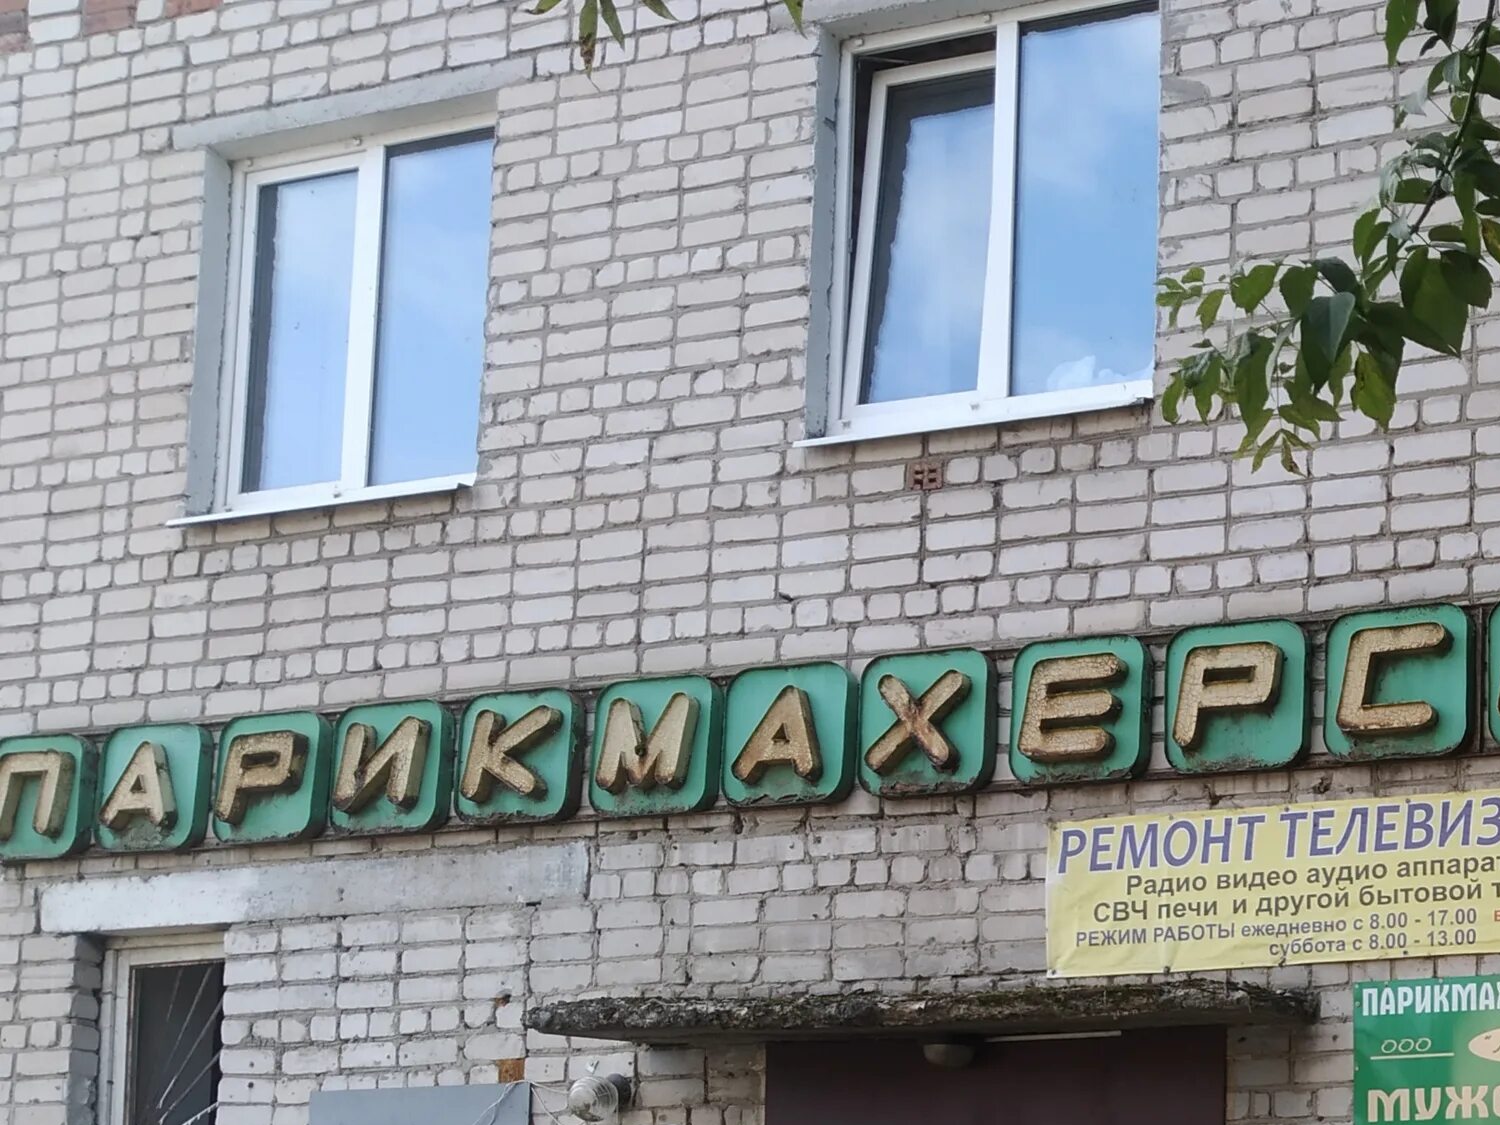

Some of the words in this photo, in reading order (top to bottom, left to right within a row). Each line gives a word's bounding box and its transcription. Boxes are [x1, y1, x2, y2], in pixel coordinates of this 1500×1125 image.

[1057, 813, 1268, 874] РЕМОНТ
[1126, 875, 1207, 897] Радио
[1216, 869, 1297, 891] видео
[1306, 861, 1388, 888] аудио
[1093, 900, 1148, 922] СВЧ
[1157, 900, 1218, 919] печи
[1232, 898, 1247, 915] и
[1255, 888, 1350, 916] другой
[1359, 878, 1483, 906] бытовой
[1076, 927, 1147, 947] РЕЖИМ
[1153, 922, 1236, 943] РАБОТЫ
[1241, 919, 1347, 938] ежедневно
[1352, 917, 1364, 931] с
[1369, 911, 1408, 930] 8.00
[1427, 908, 1477, 926] 17.00
[1268, 936, 1346, 957] суббота
[1352, 938, 1363, 951] с
[1369, 931, 1408, 950] 8.00
[1426, 928, 1477, 947] 13.00
[1380, 1037, 1432, 1053] ООО
